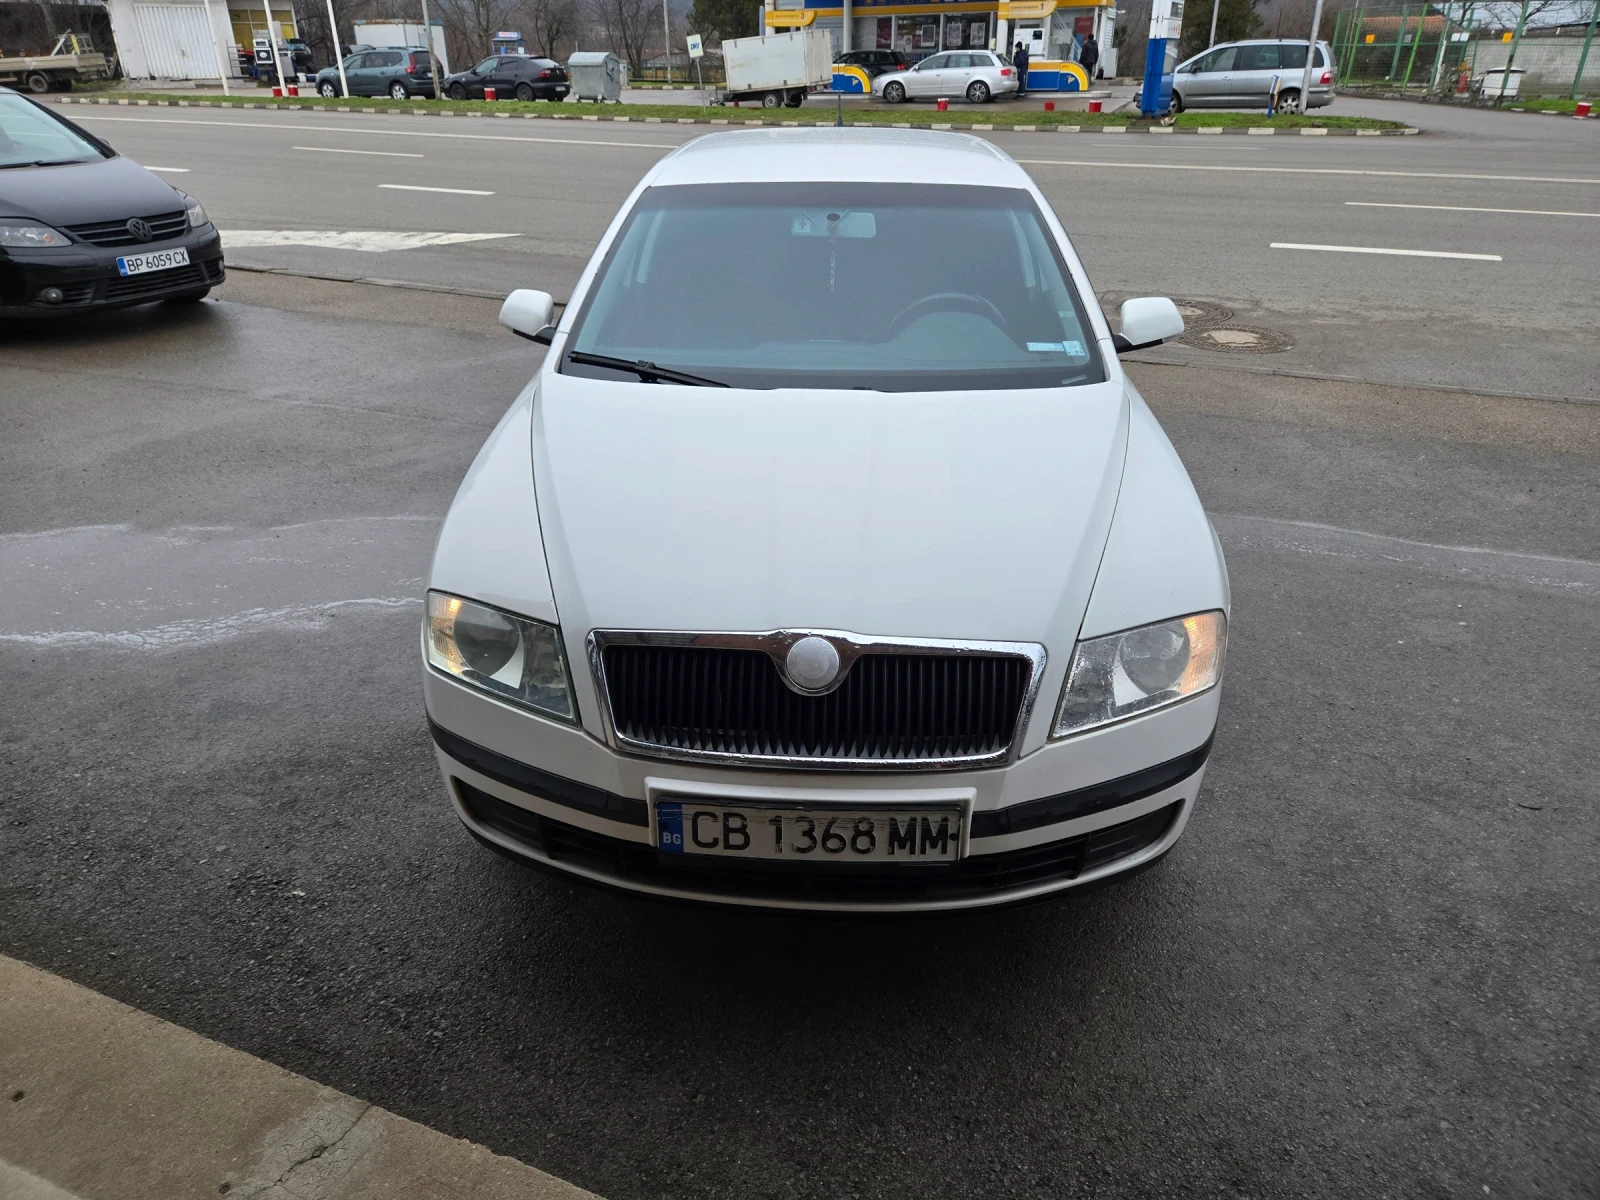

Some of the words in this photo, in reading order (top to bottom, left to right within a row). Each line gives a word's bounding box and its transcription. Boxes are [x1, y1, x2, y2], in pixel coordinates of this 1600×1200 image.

[146, 253, 172, 268] 6059
[662, 832, 681, 845] BG
[691, 811, 750, 850] CB
[768, 814, 877, 854] 1368
[888, 816, 950, 855] MM
